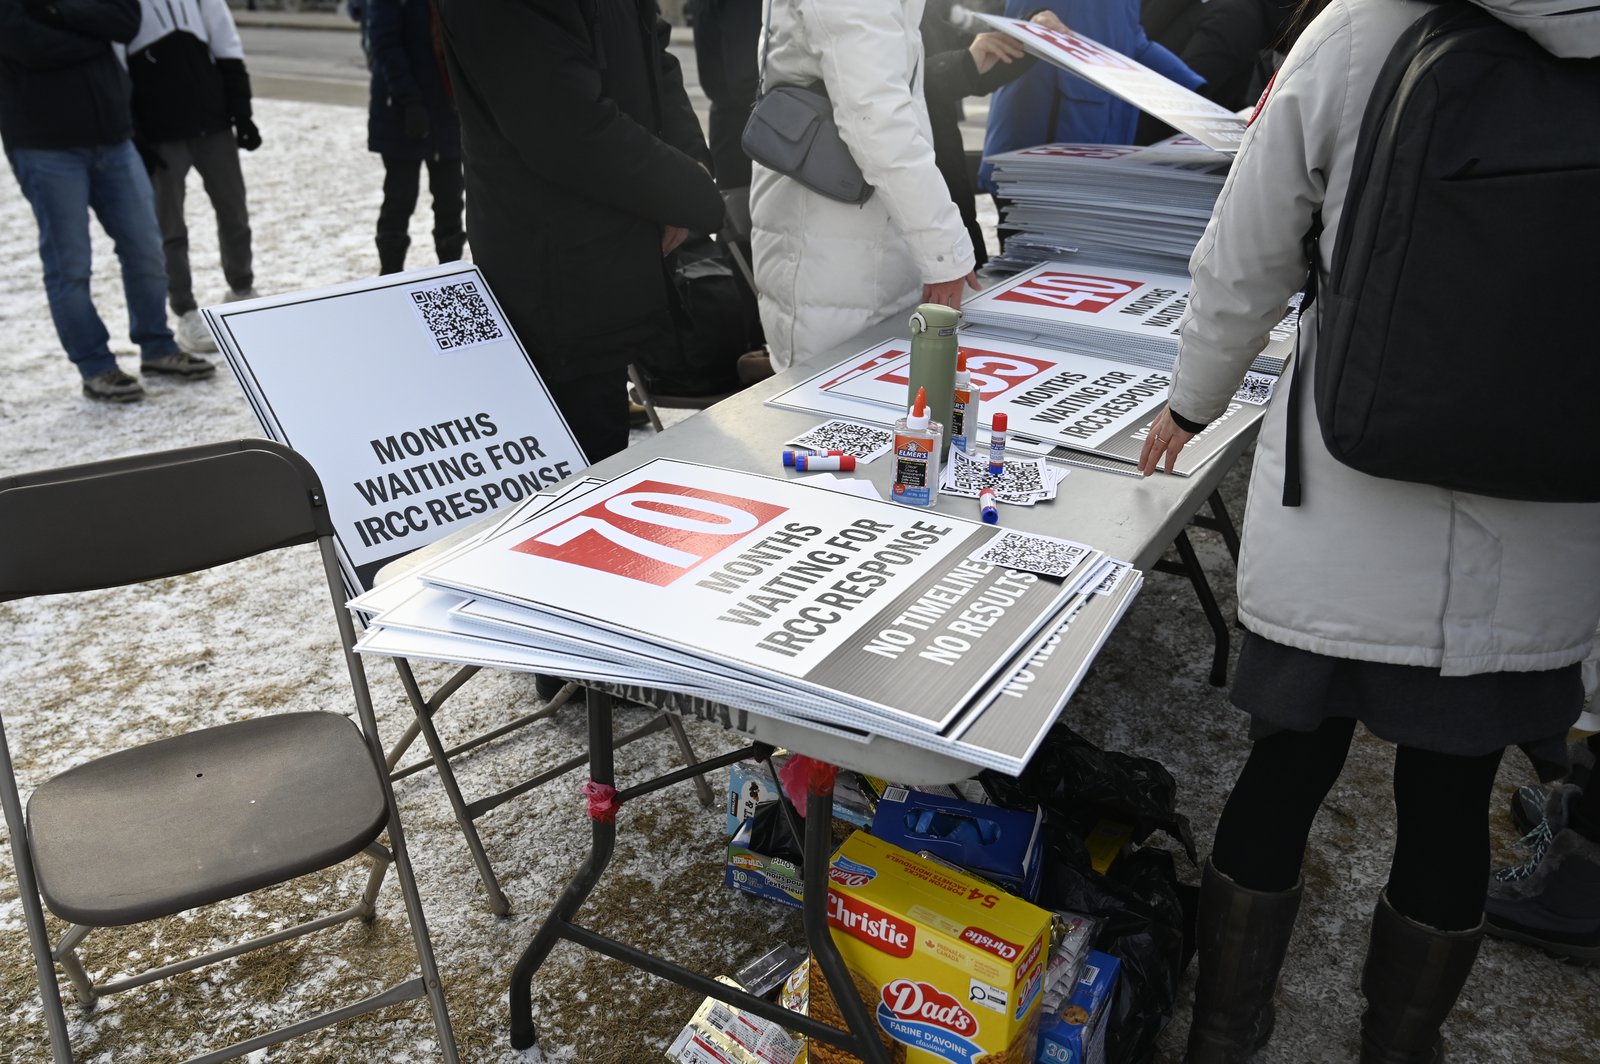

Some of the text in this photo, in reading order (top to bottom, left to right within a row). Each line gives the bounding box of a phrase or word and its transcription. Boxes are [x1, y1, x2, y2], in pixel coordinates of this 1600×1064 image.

[1010, 275, 1133, 307] 40
[1119, 288, 1177, 316] MONTHS
[1010, 371, 1087, 409] MONTHS
[1030, 370, 1138, 424] WAITING FOR
[370, 412, 499, 466] MONTHS
[1059, 412, 1113, 440] IRCC
[898, 449, 928, 459] ELMER'S
[353, 435, 547, 507] WAITING FOR
[353, 505, 429, 548] IRCC
[533, 491, 759, 570] 70
[695, 522, 823, 595] MONTHS
[716, 518, 895, 627] WAITING FOR
[754, 520, 953, 658] IRCC RESPONSE
[918, 634, 972, 666] NO
[947, 568, 1039, 639] RESULTS
[862, 628, 917, 660] NO
[732, 869, 748, 884] 10
[766, 871, 785, 882] noirs
[886, 853, 932, 879] INDIVIDUELS
[904, 867, 929, 881] PACKS
[928, 879, 964, 896] PORTION
[933, 875, 968, 892] SACHETS
[967, 887, 1000, 909] 54
[965, 930, 1017, 959] Christie
[889, 980, 971, 1031] Dad's
[890, 1021, 968, 1057] FARINE D'AVOINE
[915, 1039, 946, 1055] classique
[1045, 1042, 1069, 1063] 30
